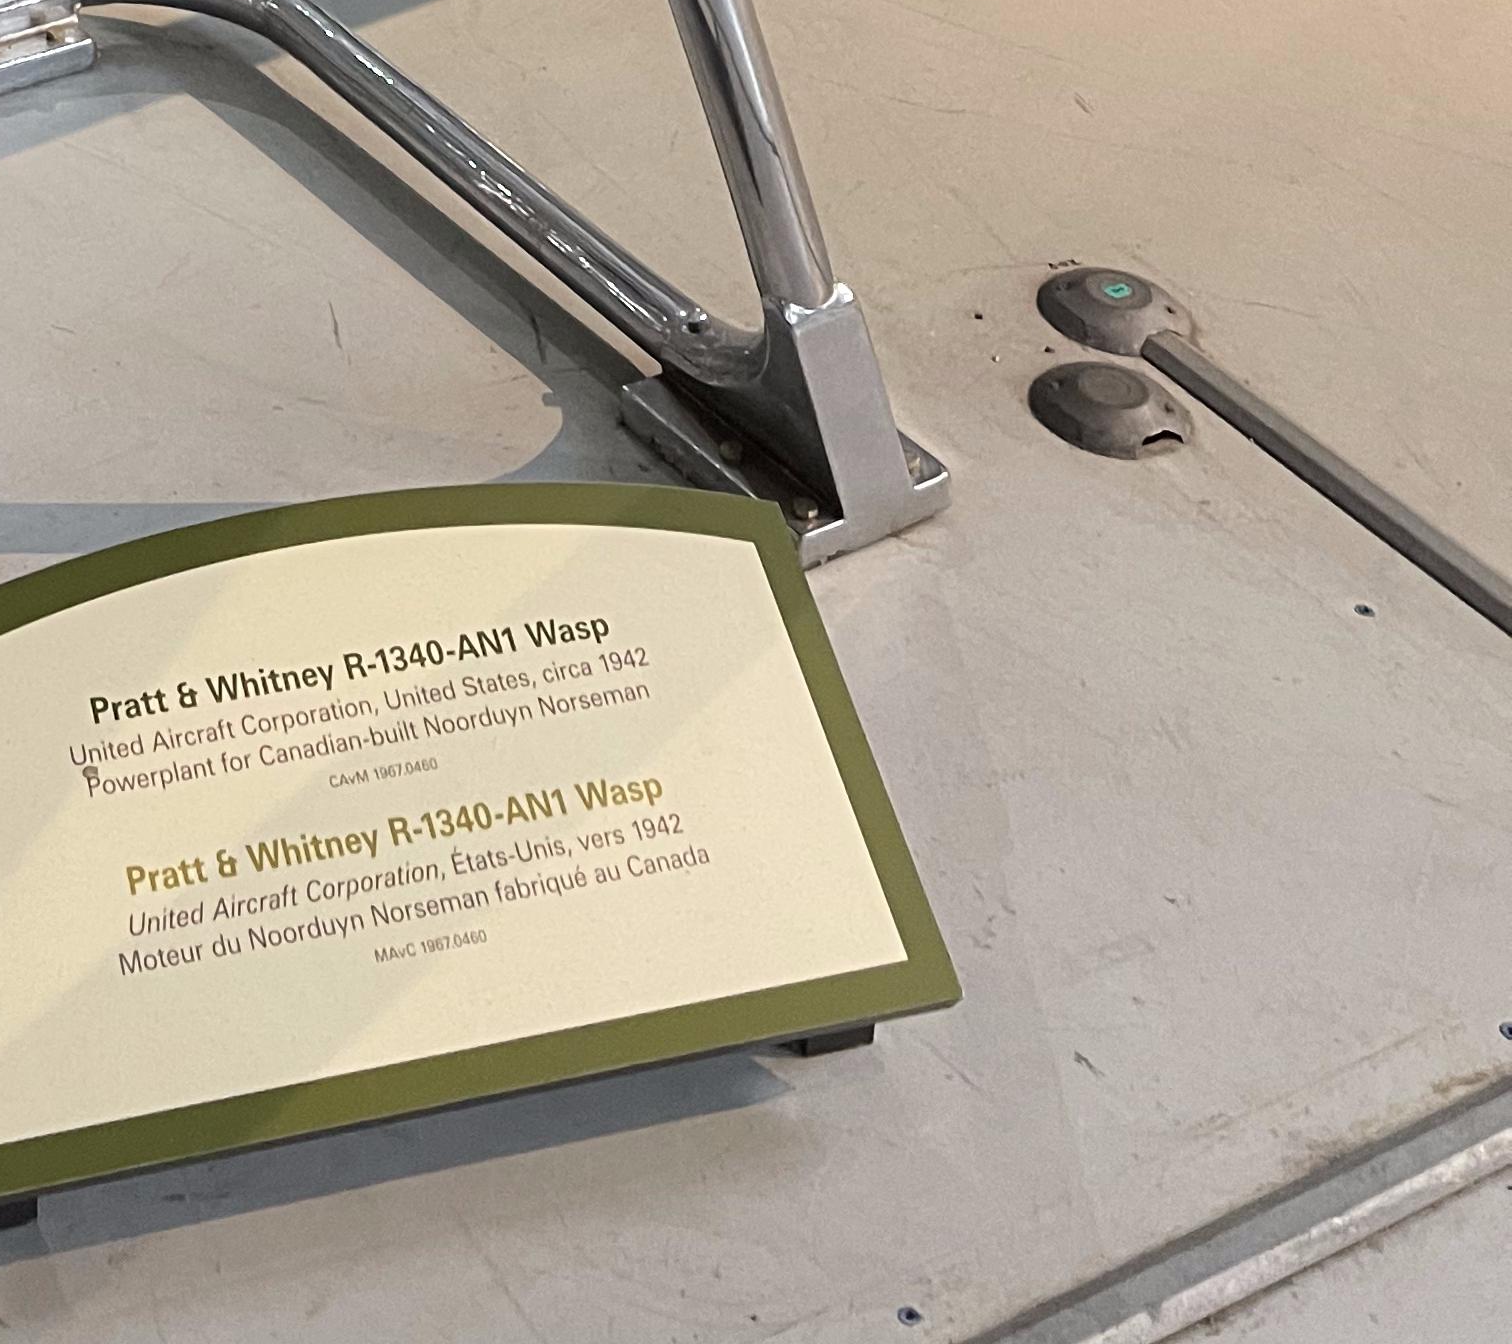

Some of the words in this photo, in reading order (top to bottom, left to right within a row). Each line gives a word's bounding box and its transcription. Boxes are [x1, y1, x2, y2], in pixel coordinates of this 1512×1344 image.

[69, 734, 144, 766] United
[152, 719, 236, 753] Aircraft
[241, 696, 379, 736] Corporation,
[384, 680, 456, 711] United
[462, 669, 537, 698] States,
[542, 659, 592, 683] circa
[598, 647, 650, 673] 1942
[89, 688, 169, 724] Pratt
[177, 681, 198, 709] &
[205, 664, 334, 703] Whitney
[343, 626, 518, 681] R-1340-AN1
[524, 617, 610, 648] Wasp
[88, 758, 216, 798] Powerplant
[221, 751, 251, 774] for
[259, 720, 419, 766] Canadian-built
[423, 702, 533, 738] Noorduyn
[538, 682, 651, 717] Norseman
[329, 771, 369, 788] CAvM
[374, 757, 439, 781] 1967.0460
[126, 857, 208, 895] Pratt
[216, 848, 238, 878] &
[245, 829, 378, 872] Whitney
[388, 788, 568, 847] R-1340-AN1
[574, 777, 663, 811] Wasp
[129, 901, 204, 936] United
[213, 884, 298, 921] Aircraft
[306, 860, 446, 903] Corporation,
[451, 835, 573, 876] États-Unis,
[577, 827, 625, 852] vers
[632, 812, 684, 841] 1942
[118, 943, 203, 976] Moteur
[212, 934, 242, 957] du
[248, 913, 365, 951] Noorduyn
[370, 886, 490, 927] Norseman
[494, 865, 588, 903] fabriqué
[595, 862, 621, 884] au
[627, 845, 710, 878] Canada
[374, 942, 417, 963] MAvC
[420, 929, 488, 954] 1967.0460
